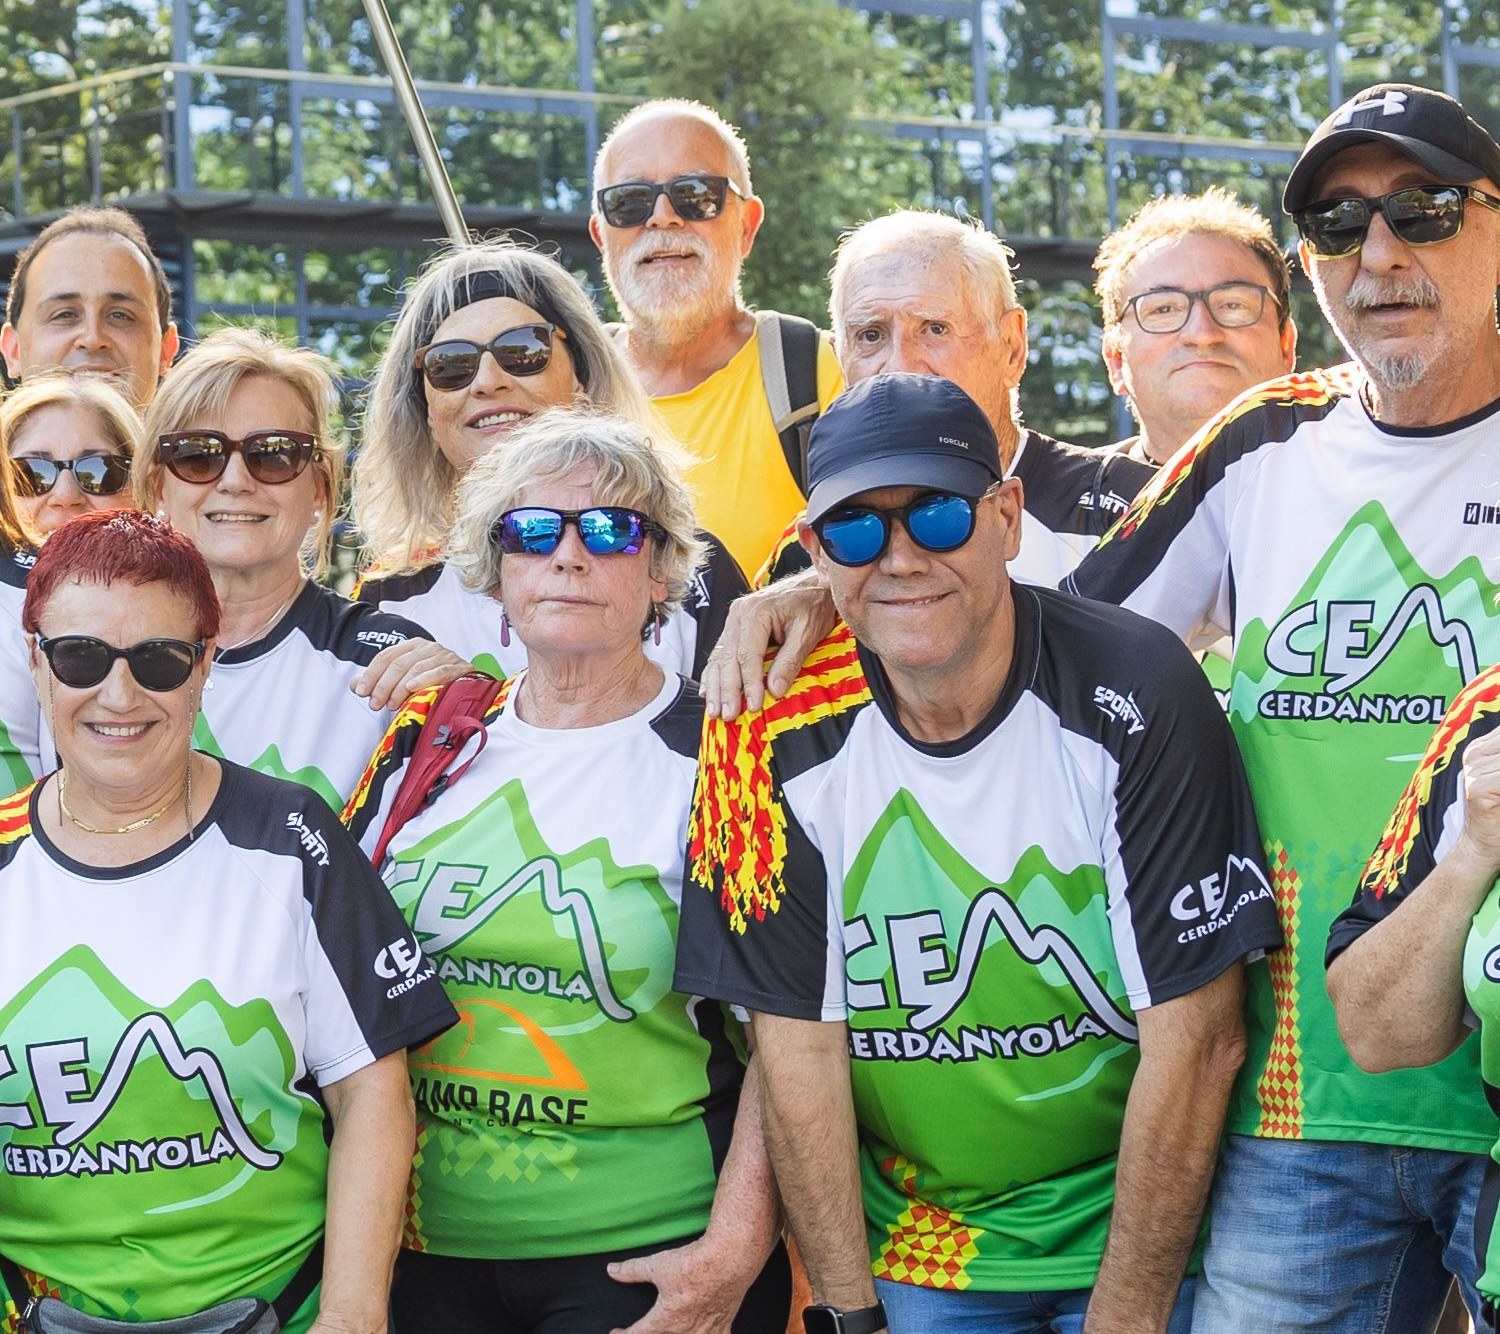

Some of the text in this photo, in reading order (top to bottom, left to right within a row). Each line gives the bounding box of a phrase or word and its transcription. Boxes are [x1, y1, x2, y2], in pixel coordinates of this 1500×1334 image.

[356, 630, 407, 647] SPORT
[1094, 683, 1145, 735] SPORTY
[1177, 887, 1270, 944] CERDANYOLA
[848, 1009, 1116, 1065] ERDANYOLA
[410, 1077, 479, 1115] AMP
[489, 1089, 588, 1127] BASE
[2, 1133, 237, 1180] CERDANYOLA
